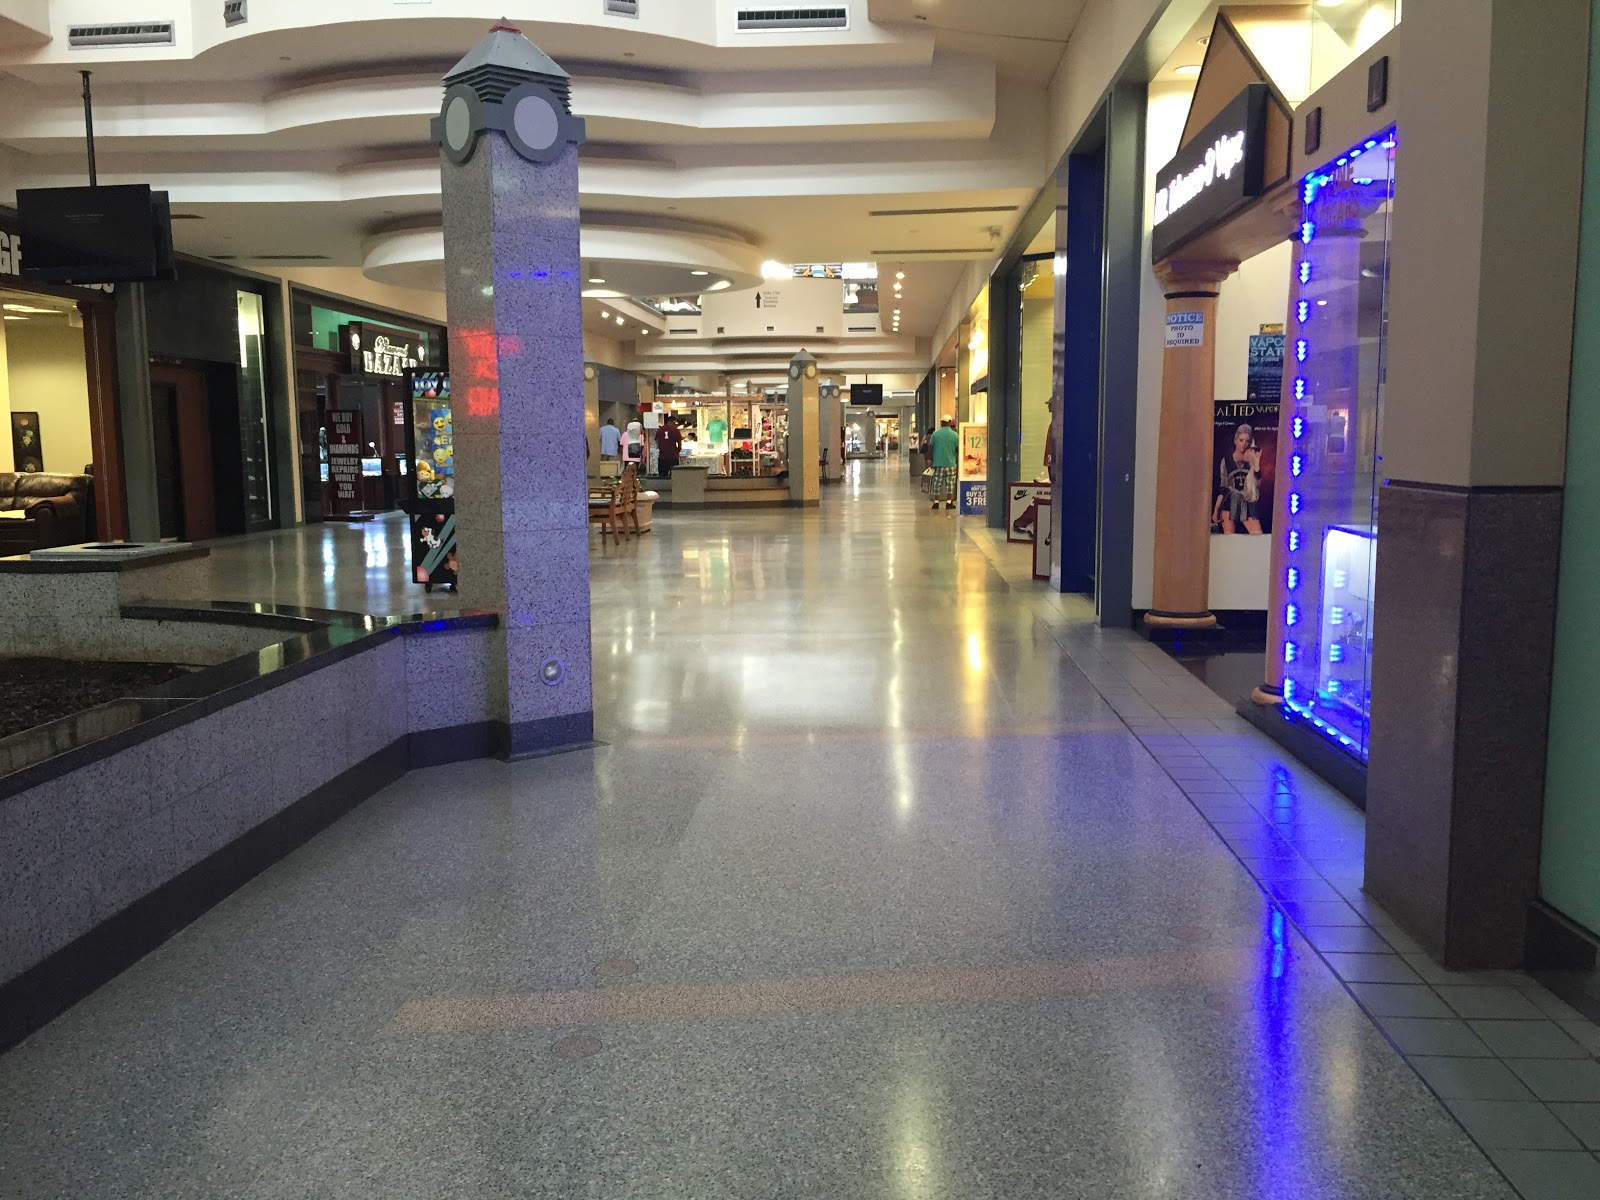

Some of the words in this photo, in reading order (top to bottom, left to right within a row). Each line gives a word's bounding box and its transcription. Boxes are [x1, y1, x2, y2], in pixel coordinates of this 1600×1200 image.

[1214, 402, 1255, 417] ALTED
[335, 424, 351, 434] GOLD
[329, 444, 359, 454] DIAMONDS
[331, 457, 359, 465] JEWELRY
[335, 474, 356, 482] WHILE
[339, 482, 353, 490] YOU
[337, 490, 355, 498] WAIT
